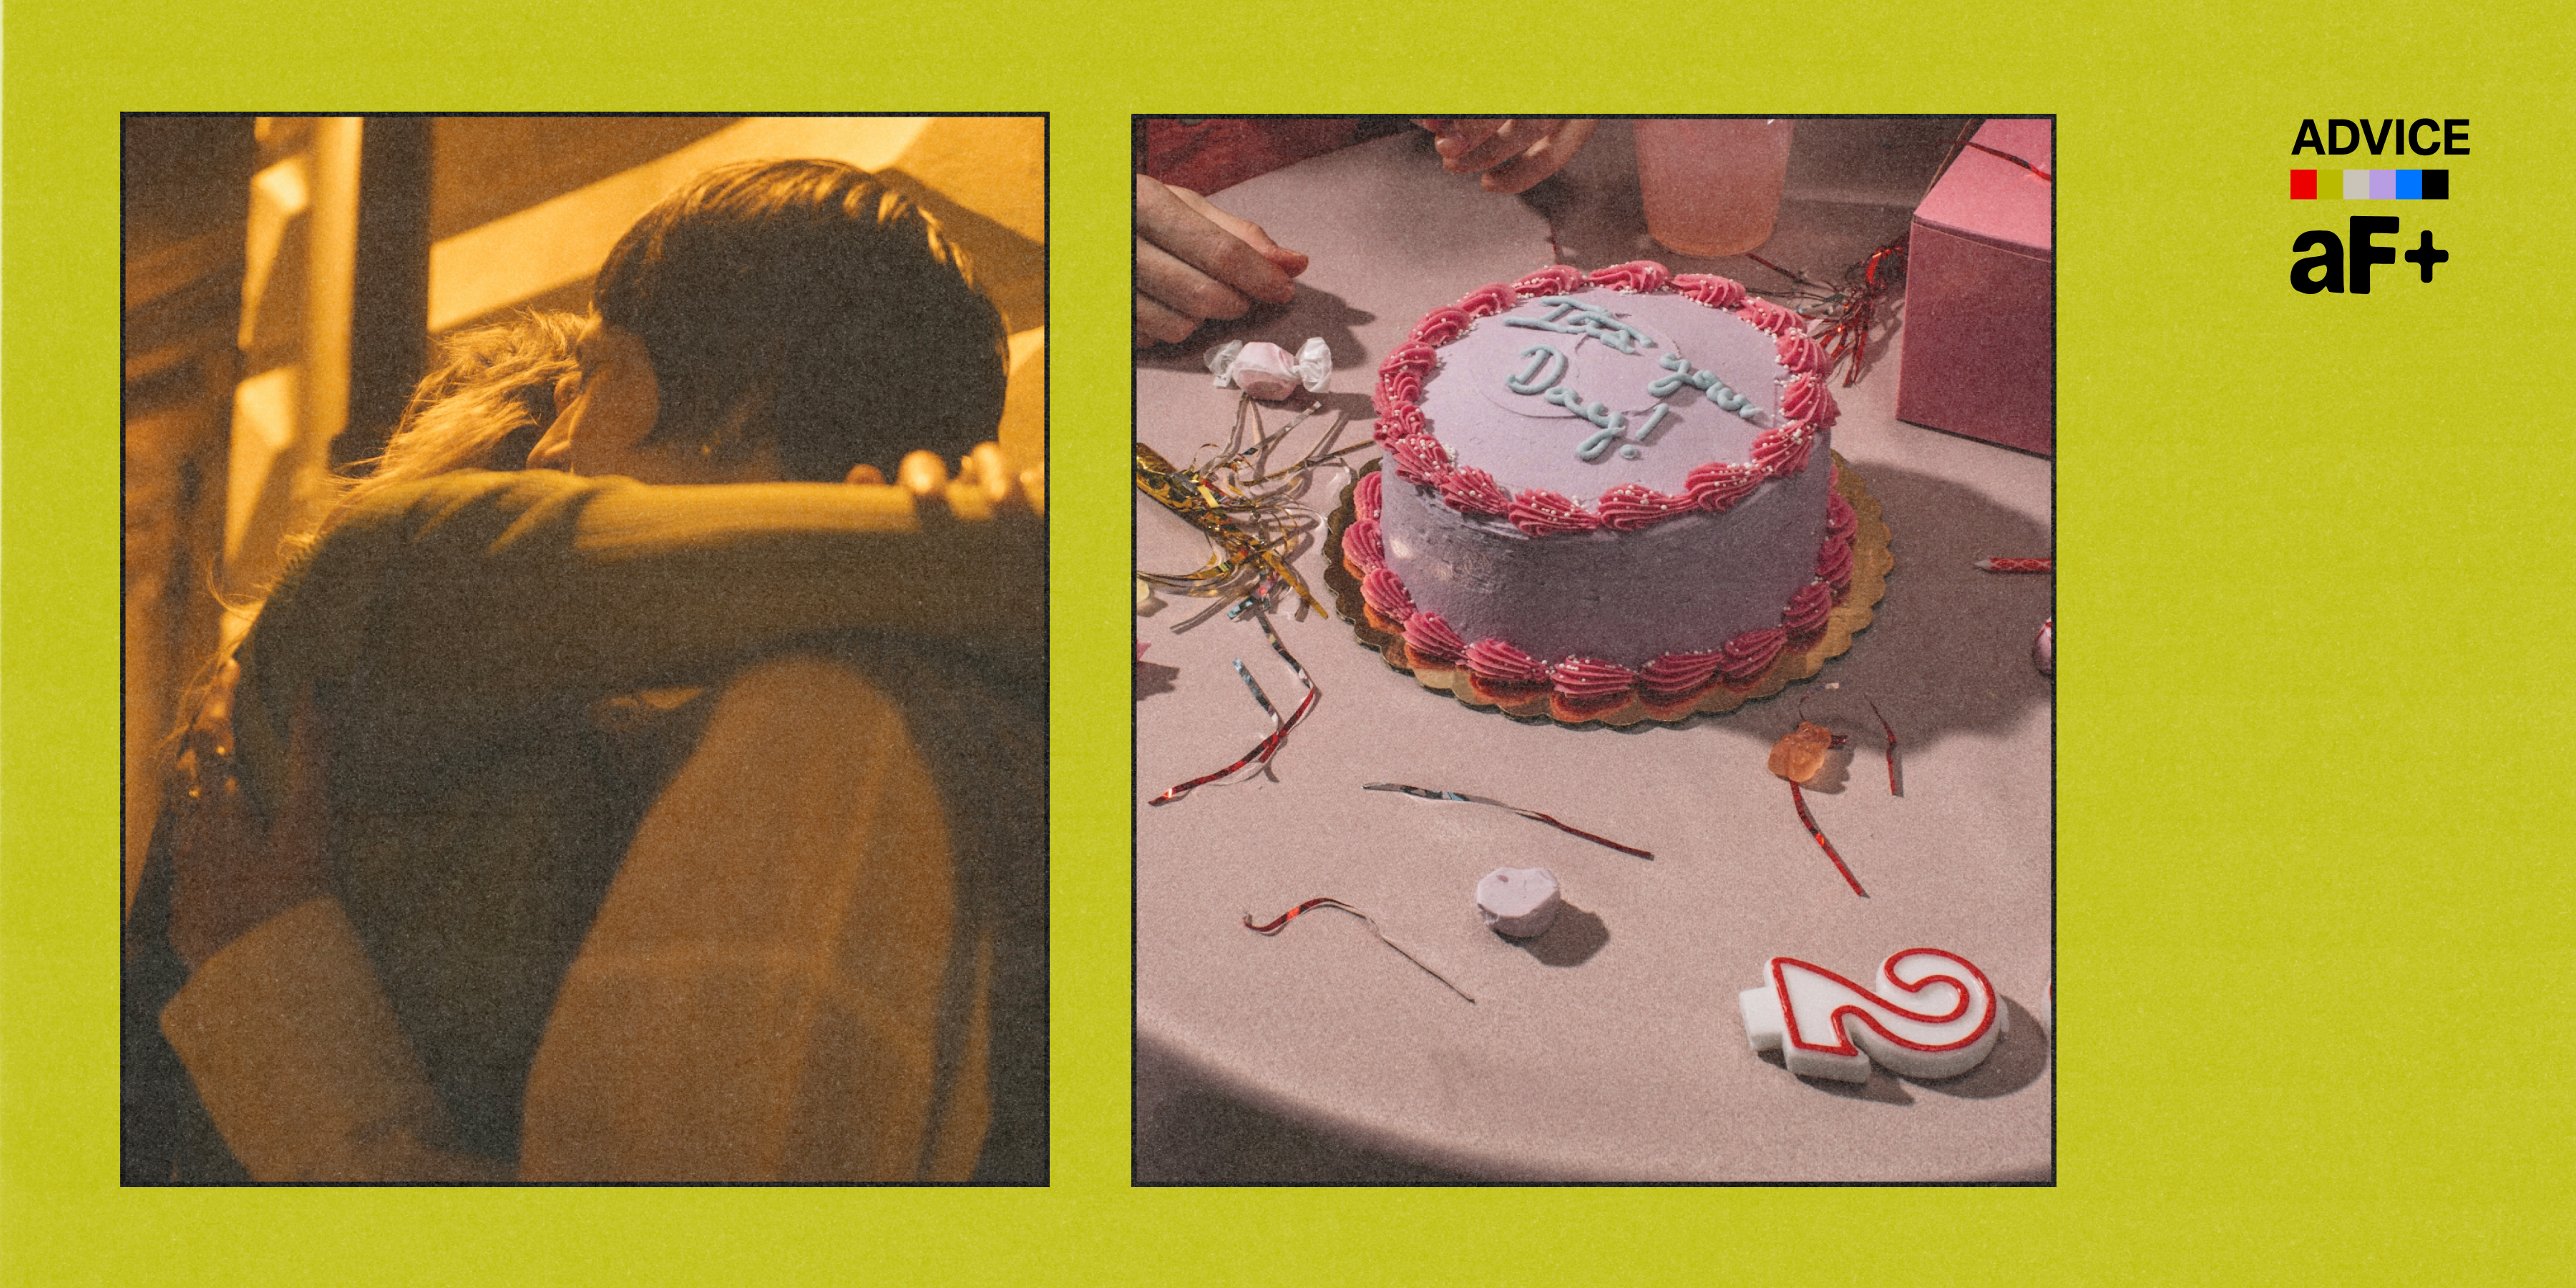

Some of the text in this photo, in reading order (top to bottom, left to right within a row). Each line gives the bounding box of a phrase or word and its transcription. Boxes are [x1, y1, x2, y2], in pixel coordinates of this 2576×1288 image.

[1505, 343, 1670, 461] Day!
[1647, 352, 1765, 419] your
[1763, 947, 2008, 1083] 2
